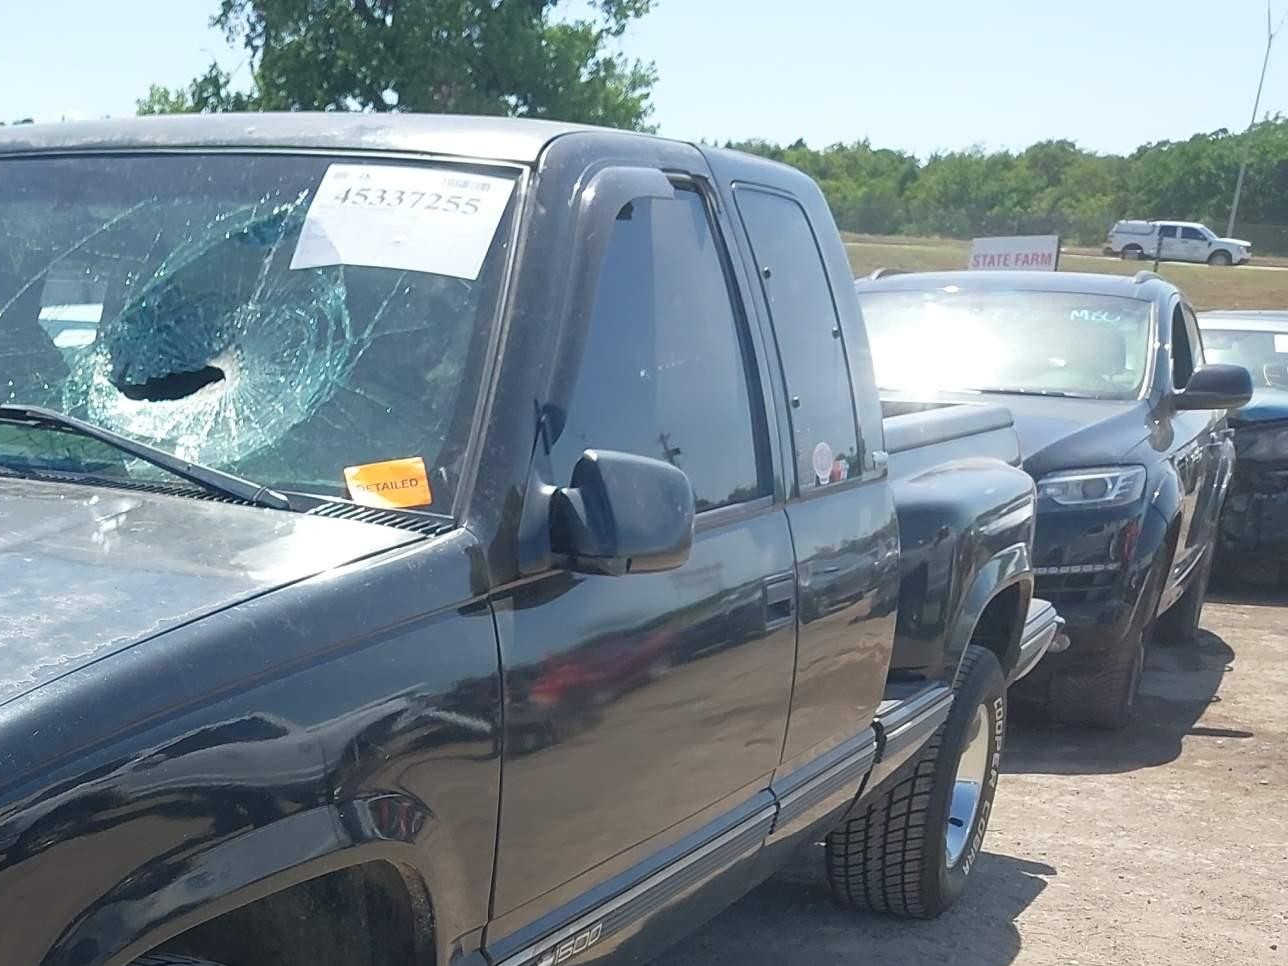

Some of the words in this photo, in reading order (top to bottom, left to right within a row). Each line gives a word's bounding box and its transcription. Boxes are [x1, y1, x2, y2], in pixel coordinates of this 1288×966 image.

[333, 188, 480, 215] 45337255
[972, 253, 1010, 268] STATE
[1015, 252, 1052, 266] FARM
[989, 697, 1004, 788] COOPER
[962, 800, 990, 876] COBRA
